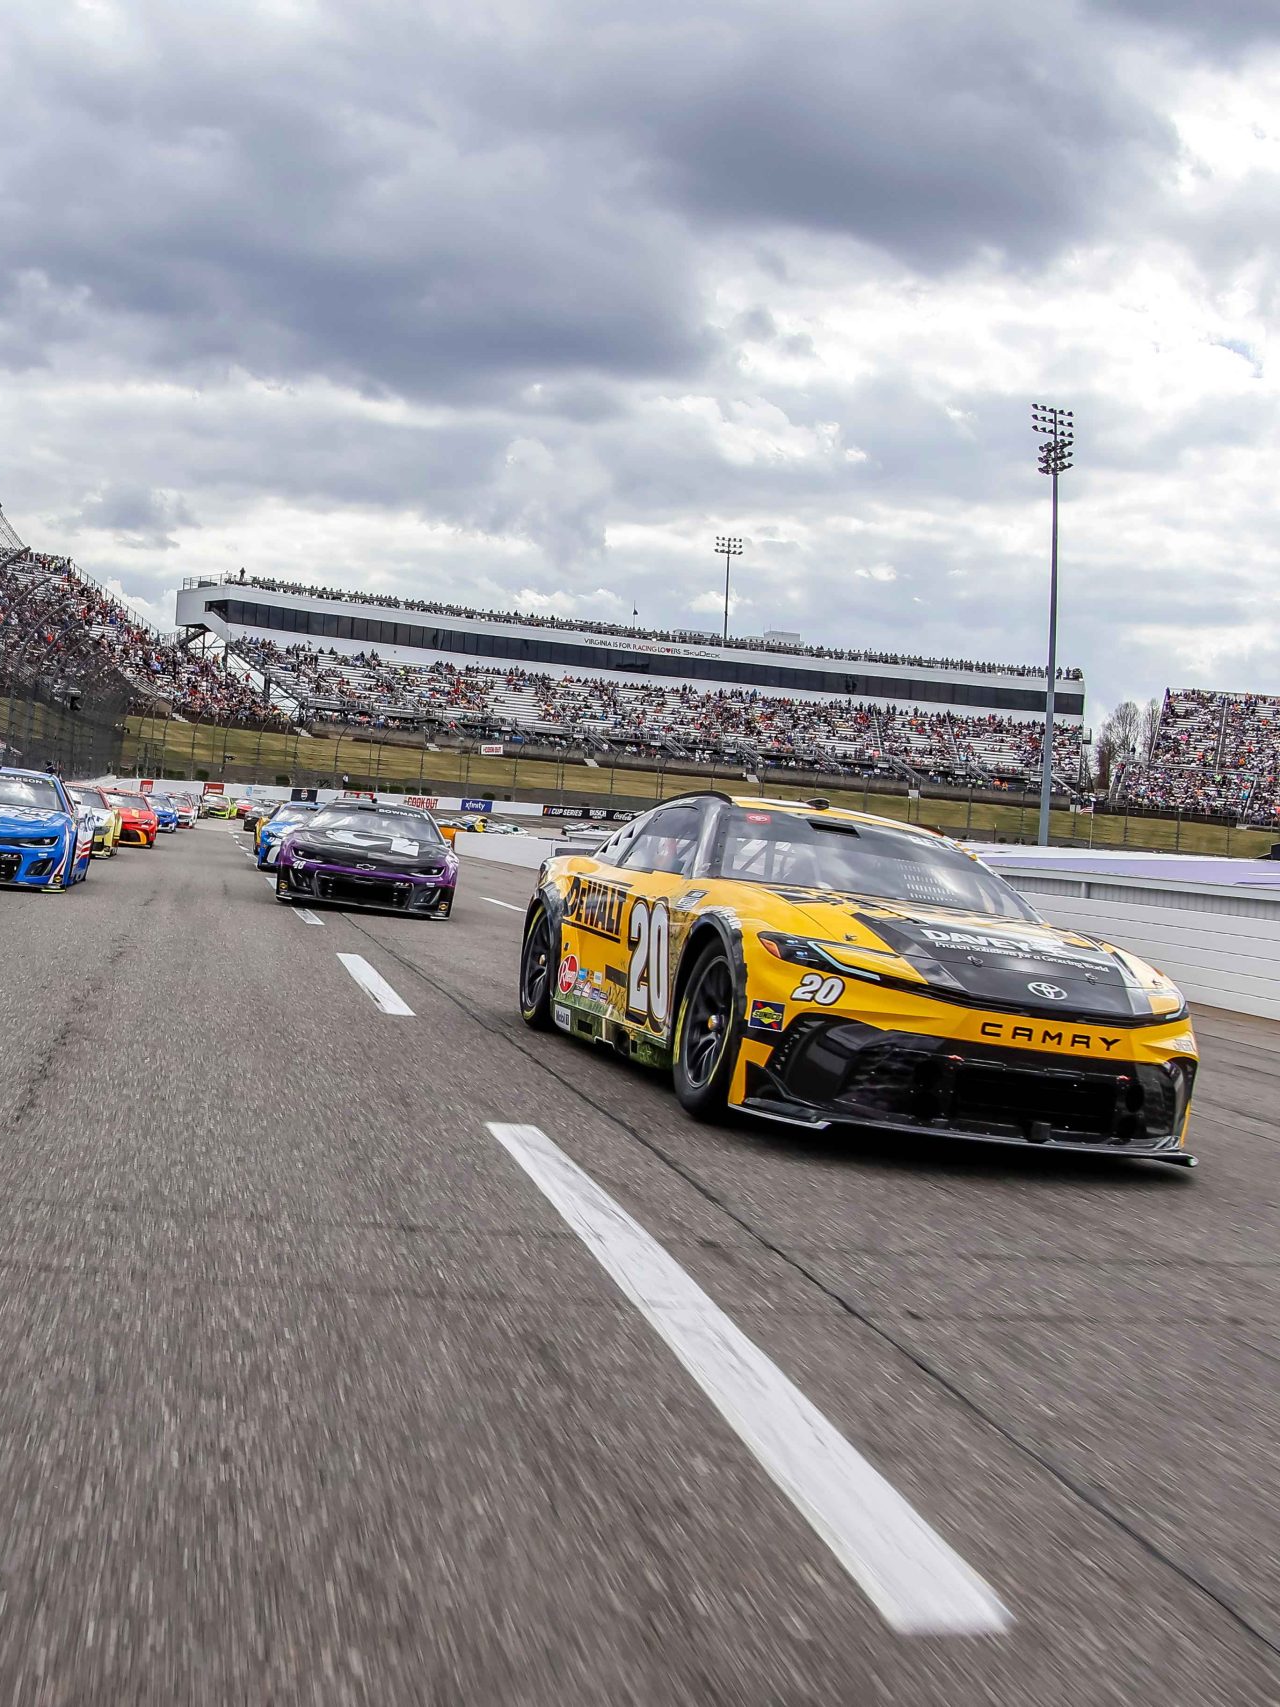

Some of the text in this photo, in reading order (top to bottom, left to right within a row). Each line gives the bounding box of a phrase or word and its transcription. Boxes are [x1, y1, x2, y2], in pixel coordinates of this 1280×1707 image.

[584, 637, 612, 647] VIRGINIA
[619, 642, 632, 650] FOR
[632, 644, 658, 653] RACING
[406, 796, 439, 810] COOK OUT
[465, 801, 486, 812] xfinity
[378, 808, 422, 819] BOWMAN
[551, 807, 583, 817] CUP SERIES
[589, 809, 607, 817] BUSCH
[292, 860, 307, 869] 48
[920, 928, 1033, 952] DAVEY
[935, 940, 971, 951] Proven
[972, 945, 1017, 957] Solutions
[1017, 949, 1033, 959] for
[1042, 955, 1085, 969] Growing
[1081, 961, 1111, 973] World
[626, 898, 671, 1031] 20
[790, 973, 846, 1006] 20
[556, 1009, 565, 1024] Mobil
[753, 1010, 782, 1021] SUNOCO
[980, 1020, 1122, 1052] CAMRY
